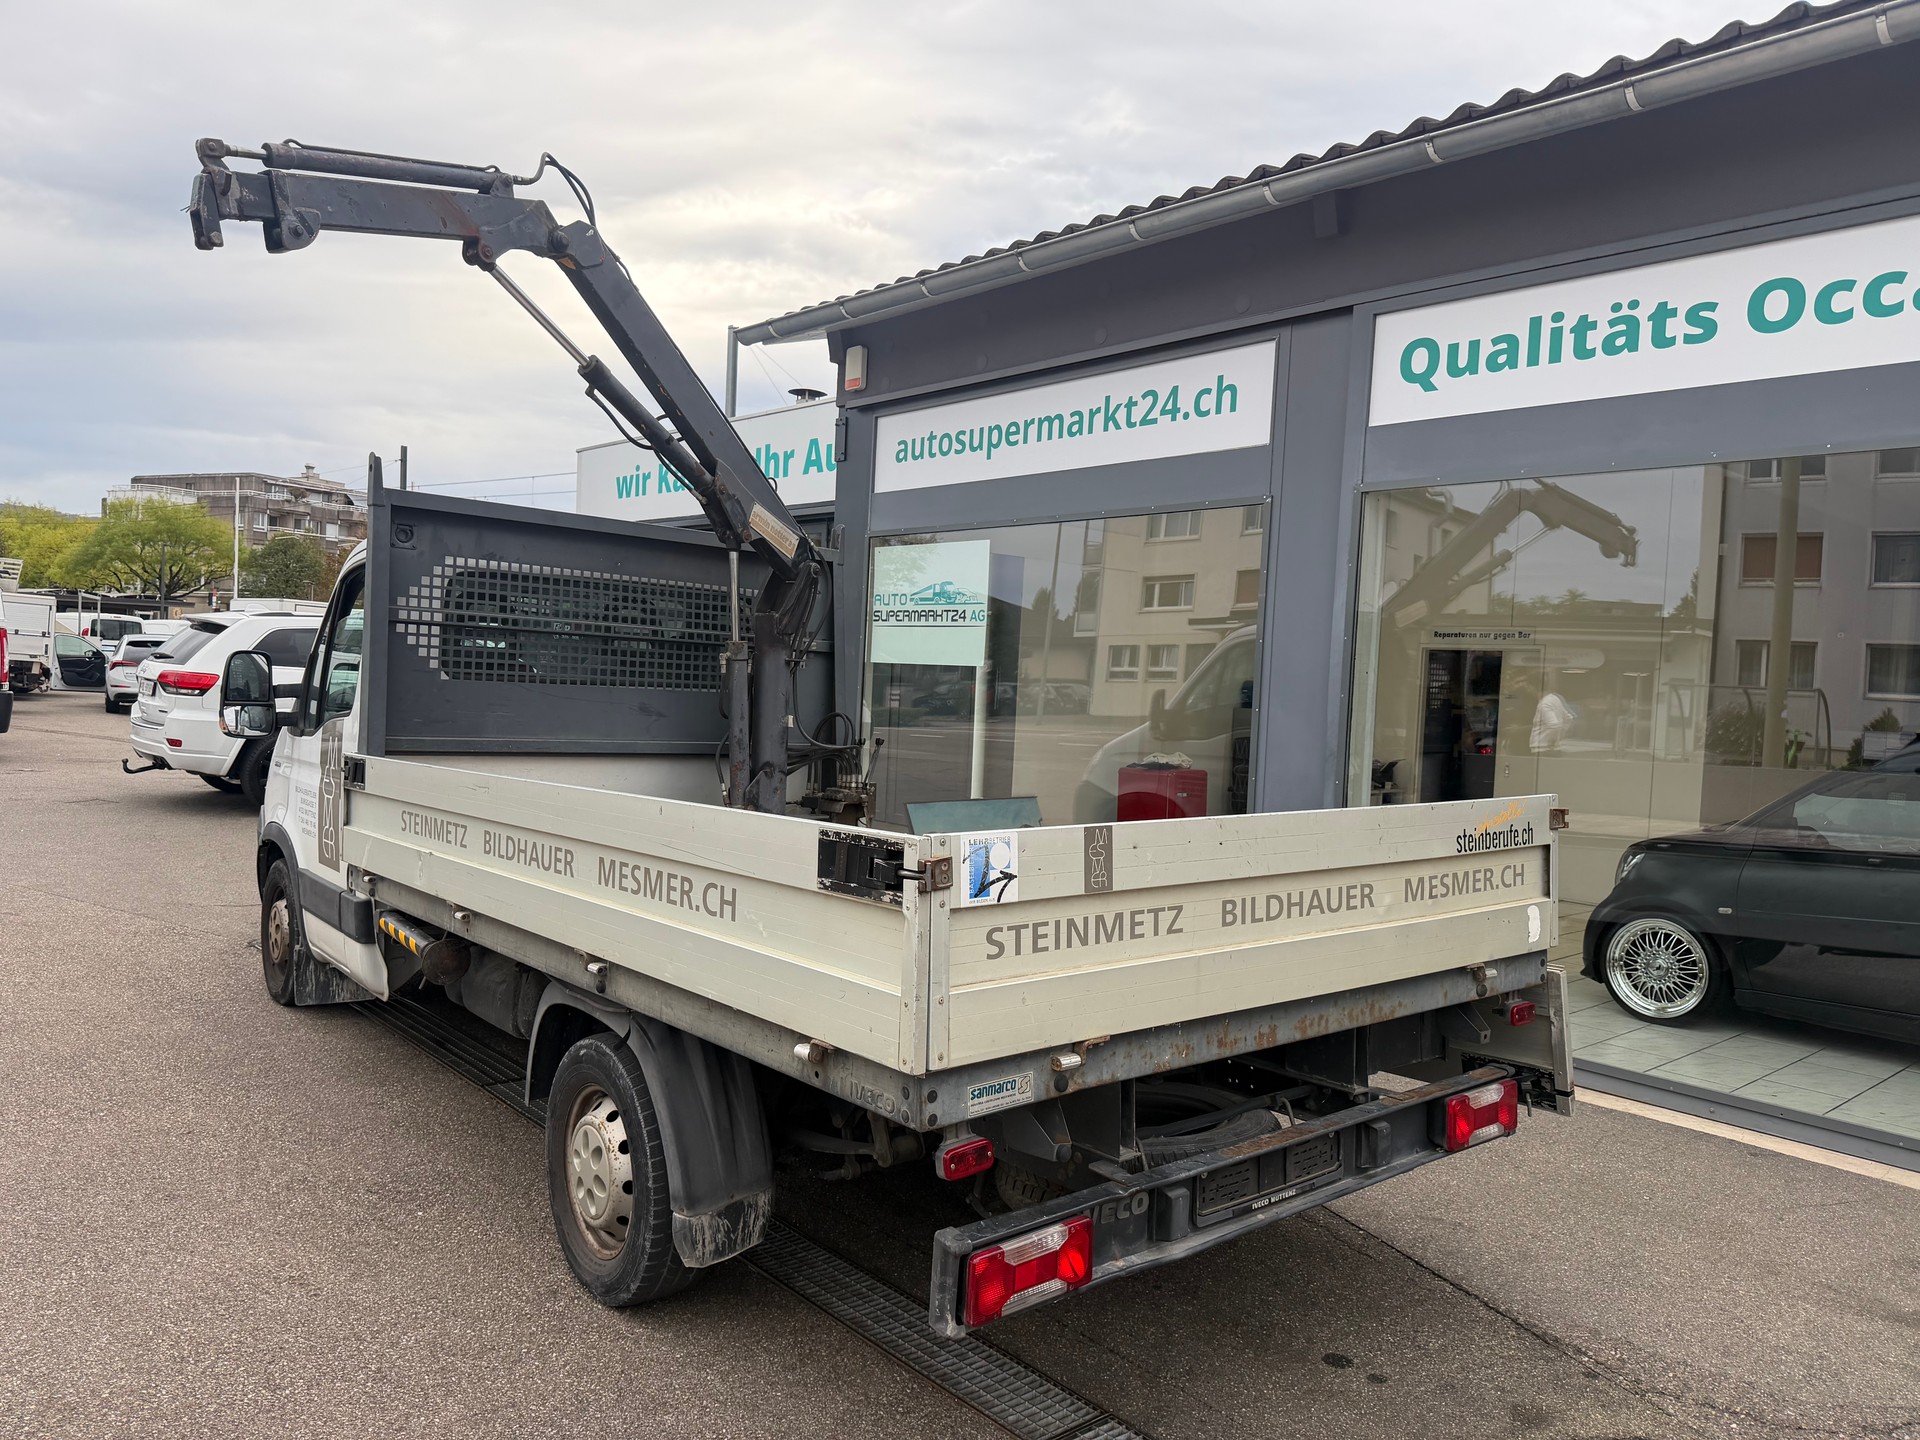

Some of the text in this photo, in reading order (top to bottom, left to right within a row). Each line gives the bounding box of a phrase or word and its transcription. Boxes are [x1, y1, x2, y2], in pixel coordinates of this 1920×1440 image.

[1399, 299, 1719, 392] Qualitäts
[895, 374, 1238, 463] autosupermarkt24.ch
[616, 464, 651, 499] wir
[873, 609, 985, 622] SUPERMARKT24 AG
[874, 594, 907, 606] AUTO
[1433, 631, 1477, 639] Reparaturen
[1493, 632, 1515, 640] gegen
[1518, 631, 1531, 639] Bar
[1456, 821, 1533, 853] steinberufe.ch
[401, 810, 737, 922] STEINMETZ BILDHAUER MESMER.CH
[986, 863, 1525, 960] STEINMETZ BILDHAUER MESMER.CH
[970, 1079, 1017, 1100] sanmarco
[1251, 1188, 1297, 1210] IVECO MUTTENZ
